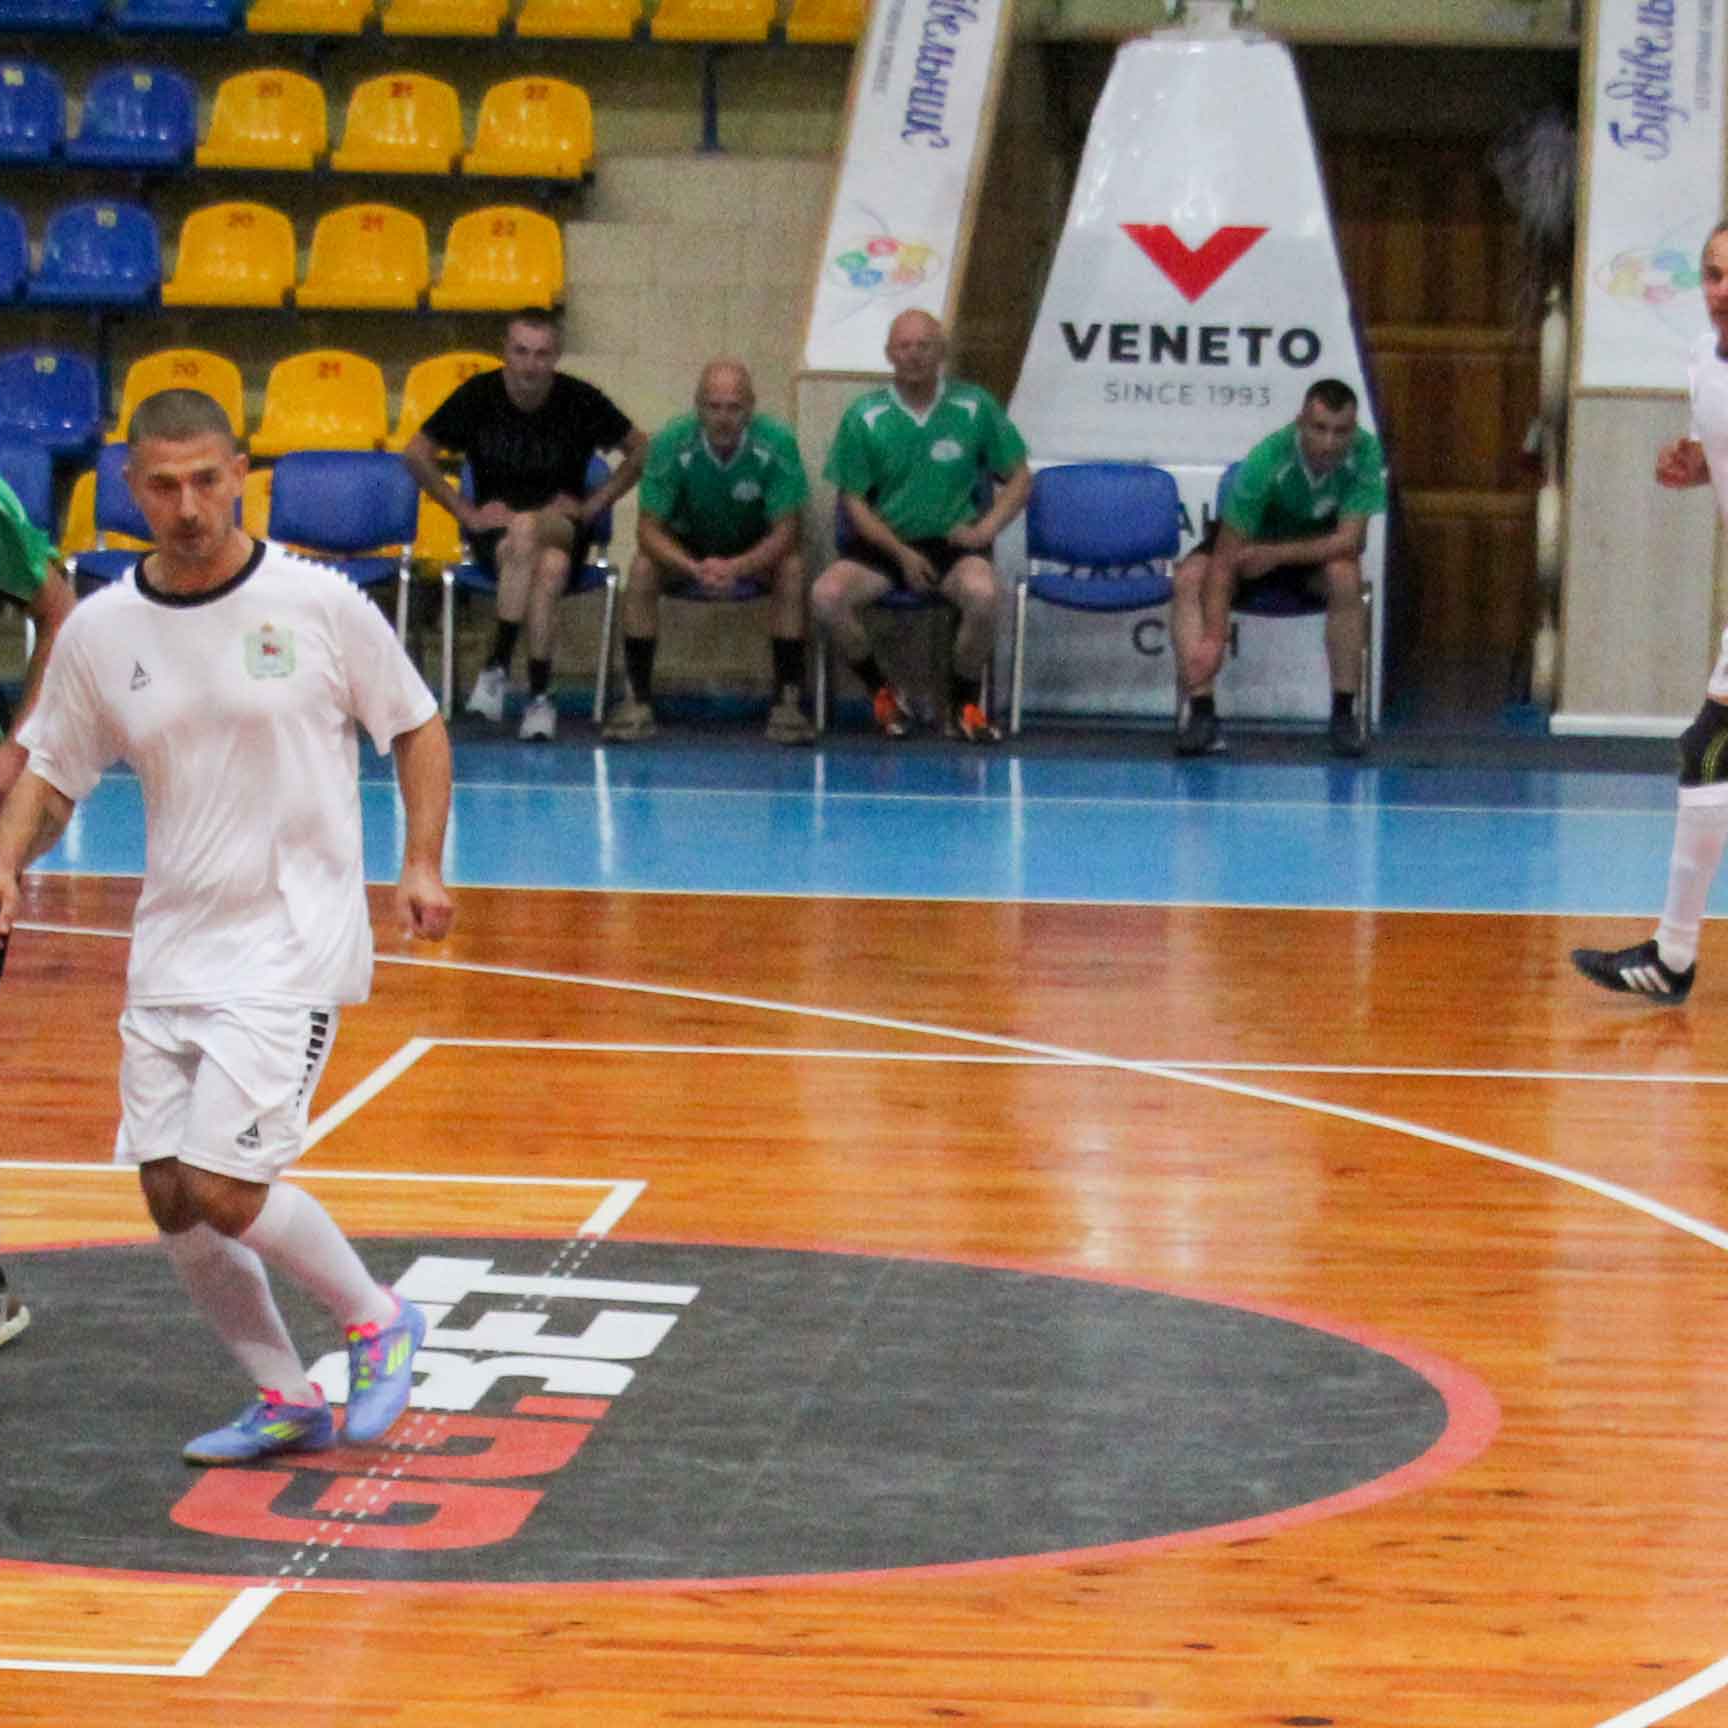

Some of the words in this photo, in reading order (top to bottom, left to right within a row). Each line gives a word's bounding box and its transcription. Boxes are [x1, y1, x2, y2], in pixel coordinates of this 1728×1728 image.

[1059, 322, 1323, 368] VENETO
[1103, 382, 1194, 406] SINCE
[1208, 383, 1272, 407] 1993
